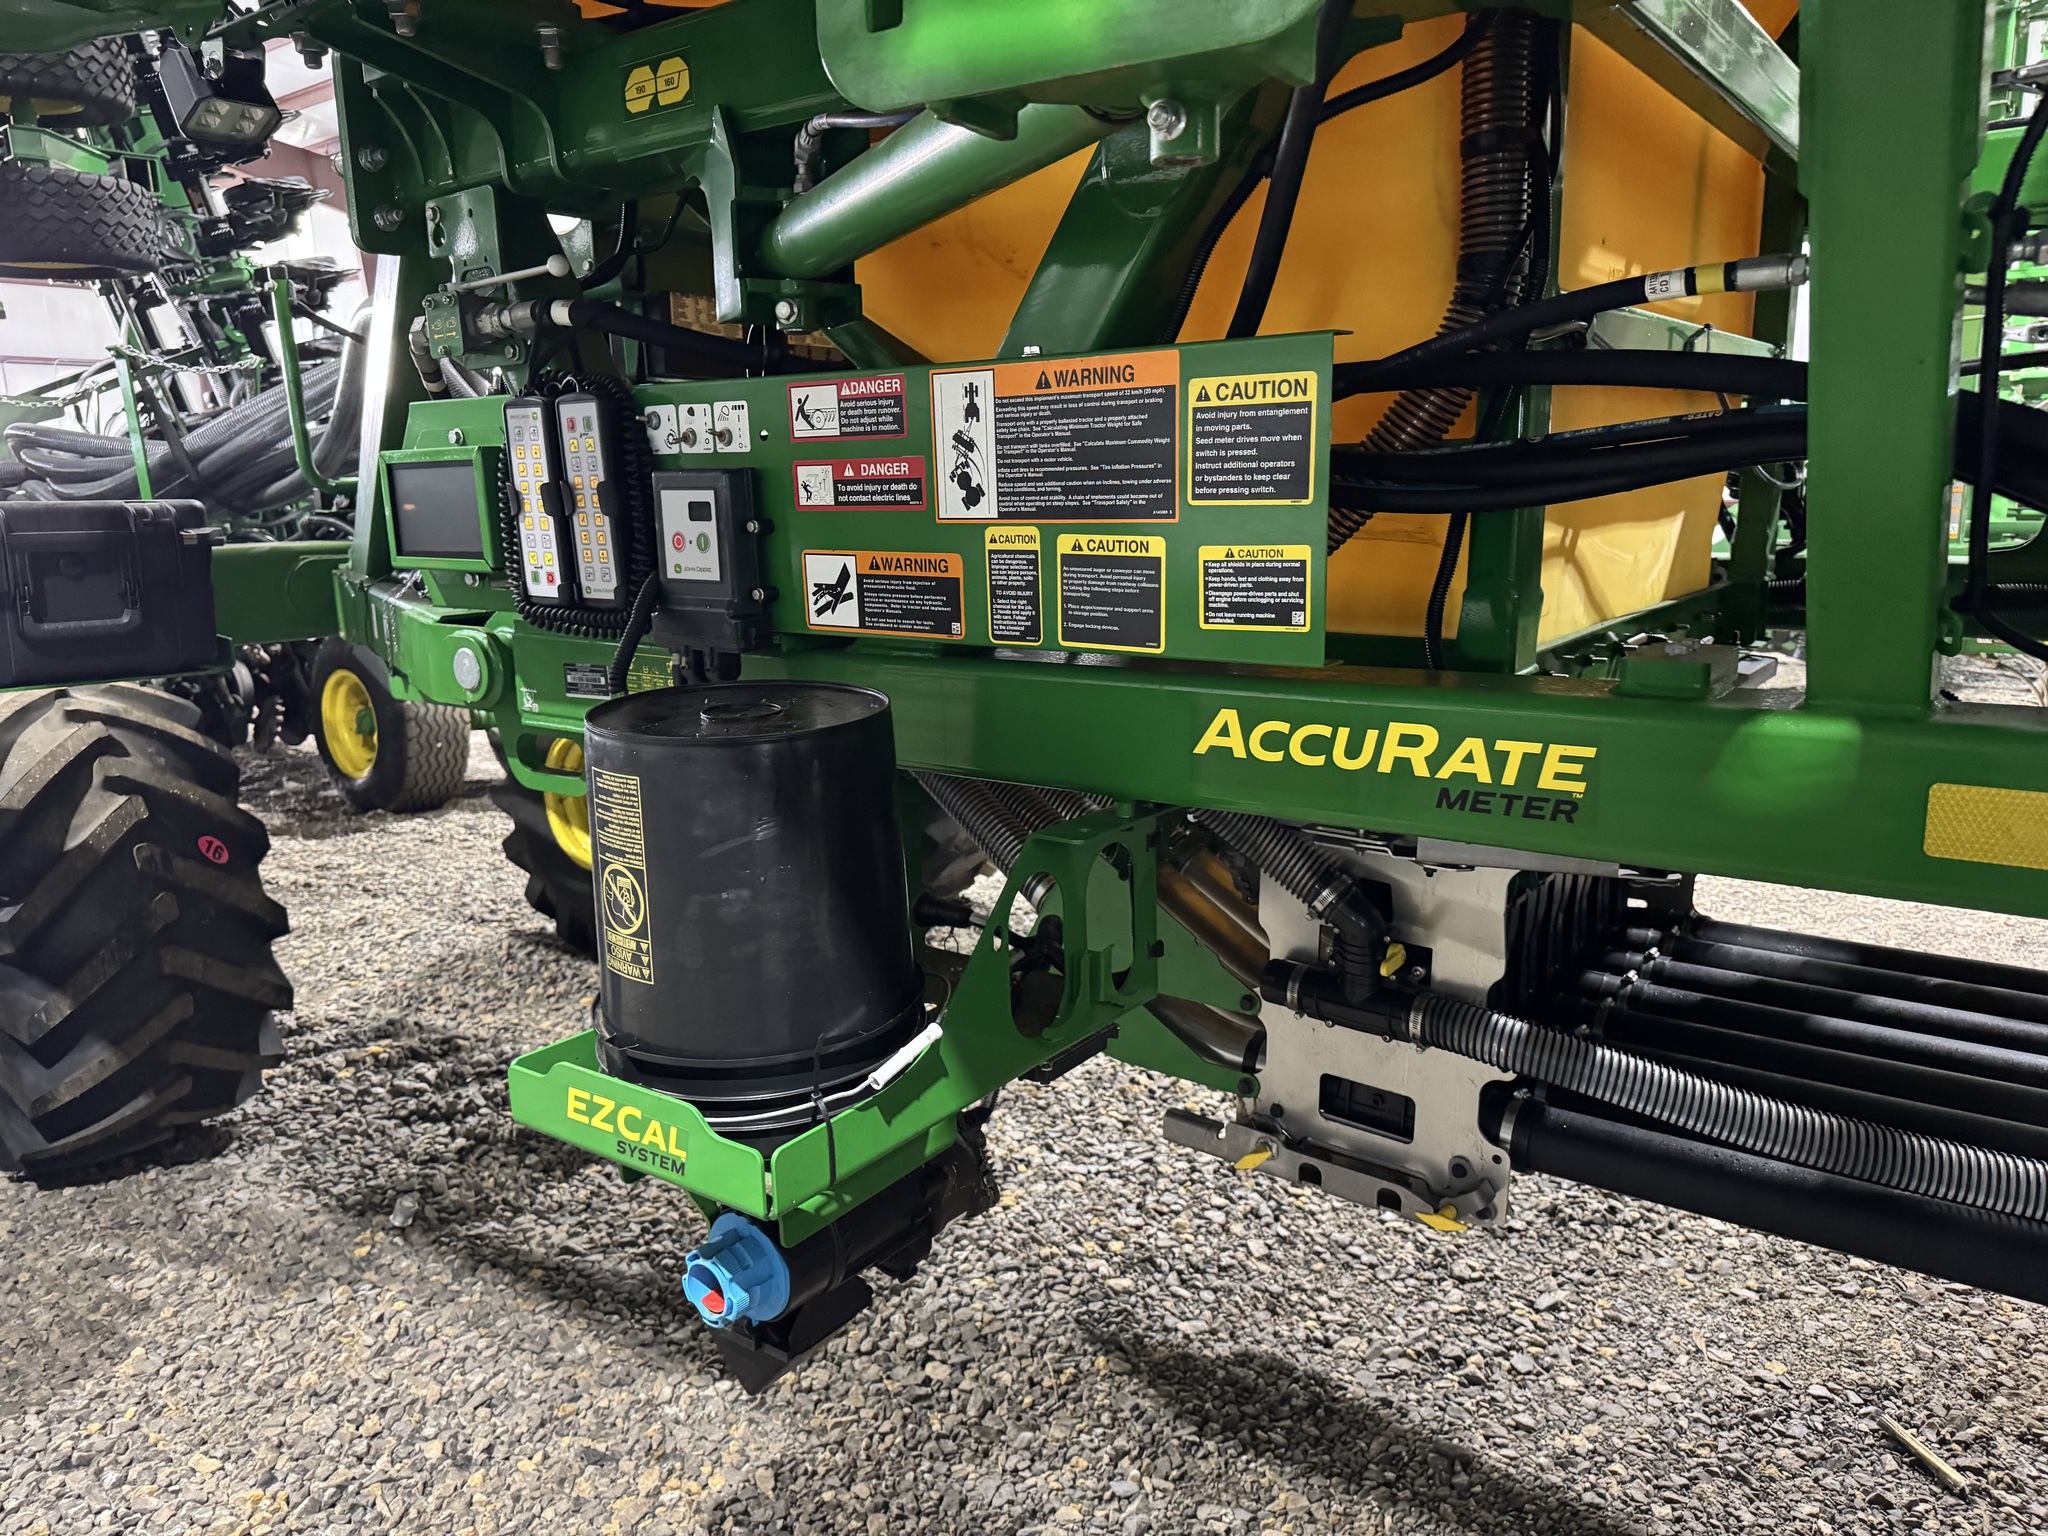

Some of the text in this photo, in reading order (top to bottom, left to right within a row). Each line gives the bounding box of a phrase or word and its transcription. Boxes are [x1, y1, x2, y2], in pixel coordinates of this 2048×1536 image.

[635, 77, 675, 95] 190 160
[1659, 279, 1669, 293] CD
[1053, 364, 1135, 387] WARNING
[850, 379, 901, 395] DANGER
[1216, 378, 1308, 401] CAUTION
[840, 400, 856, 408] Avoid
[878, 398, 895, 407] injury
[847, 408, 863, 416] death
[1196, 411, 1216, 419] Avoid
[1217, 411, 1238, 420] injury
[1257, 407, 1308, 417] entanglement
[840, 417, 849, 425] Do
[860, 416, 878, 425] adjust
[841, 425, 864, 433] machine
[865, 423, 871, 432] is
[878, 423, 900, 431] motion.
[1195, 423, 1252, 433] in moving parts.
[1195, 437, 1213, 445] Seed
[1195, 449, 1218, 457] switch
[1227, 448, 1258, 457] pressed.
[861, 462, 909, 476] DANGER
[1223, 461, 1259, 469] additional
[1260, 460, 1296, 469] operators
[1204, 474, 1243, 483] bystanders
[1253, 473, 1271, 482] keep
[837, 483, 846, 492] To
[846, 483, 863, 492] avoid
[864, 483, 882, 493] injury
[890, 483, 908, 491] death
[908, 482, 918, 491] do
[1195, 486, 1217, 494] before
[1218, 487, 1250, 495] pressing
[838, 493, 911, 502] not contact electric lines
[998, 534, 1036, 544] CAUTION
[1086, 539, 1149, 553] CAUTION
[1238, 549, 1284, 559] CAUTION
[683, 565, 712, 574] JOHN DEERE
[880, 557, 949, 573] WARNING
[1215, 595, 1231, 603] engine
[1435, 787, 1580, 824] METER
[205, 839, 224, 861] 16
[610, 945, 633, 962] AVISO
[606, 953, 642, 978] WARNING
[616, 1140, 686, 1177] SYSTEM
